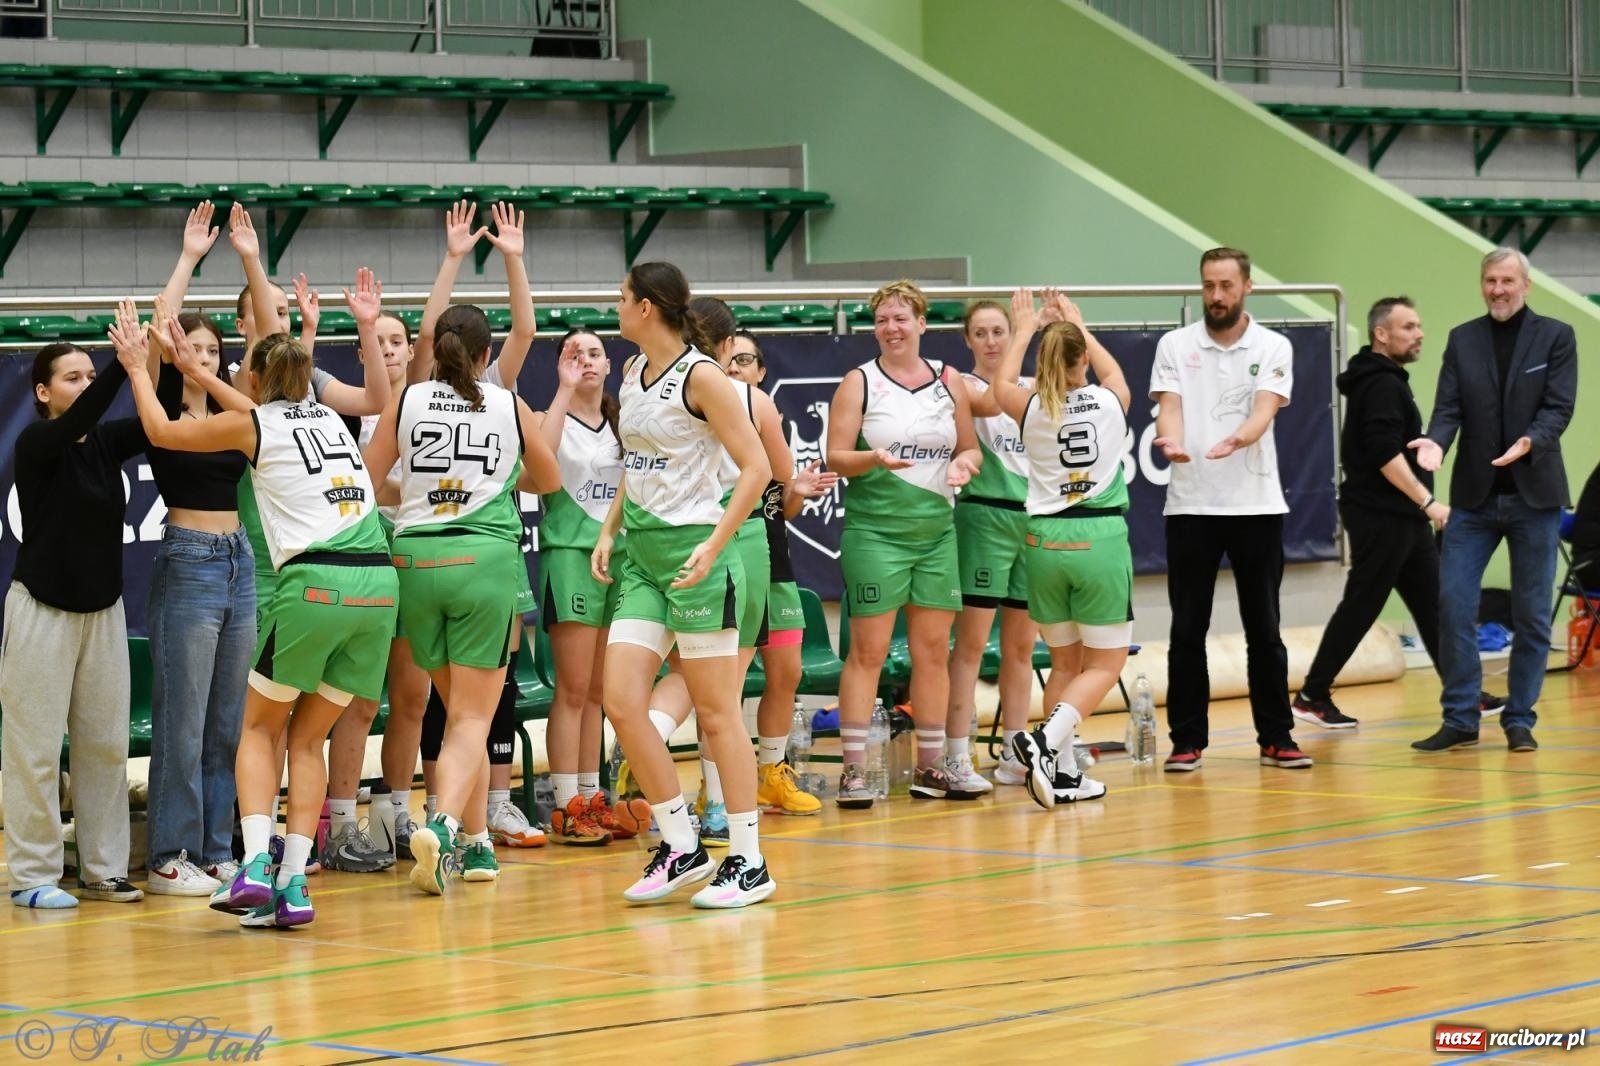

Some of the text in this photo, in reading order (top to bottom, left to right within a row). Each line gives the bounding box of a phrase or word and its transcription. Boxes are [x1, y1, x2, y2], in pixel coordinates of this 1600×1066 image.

[1066, 403, 1100, 414] IBÓRZ
[293, 427, 363, 475] 14
[411, 421, 501, 476] 24
[900, 444, 951, 460] Clavis
[1004, 438, 1026, 453] Cla
[1057, 421, 1099, 468] 3
[328, 487, 362, 504] SEGET
[431, 490, 469, 503] SEGET
[592, 482, 617, 500] Cla
[975, 568, 992, 588] 9
[857, 582, 881, 604] 10
[571, 593, 587, 615] 8
[499, 742, 512, 754] NBA
